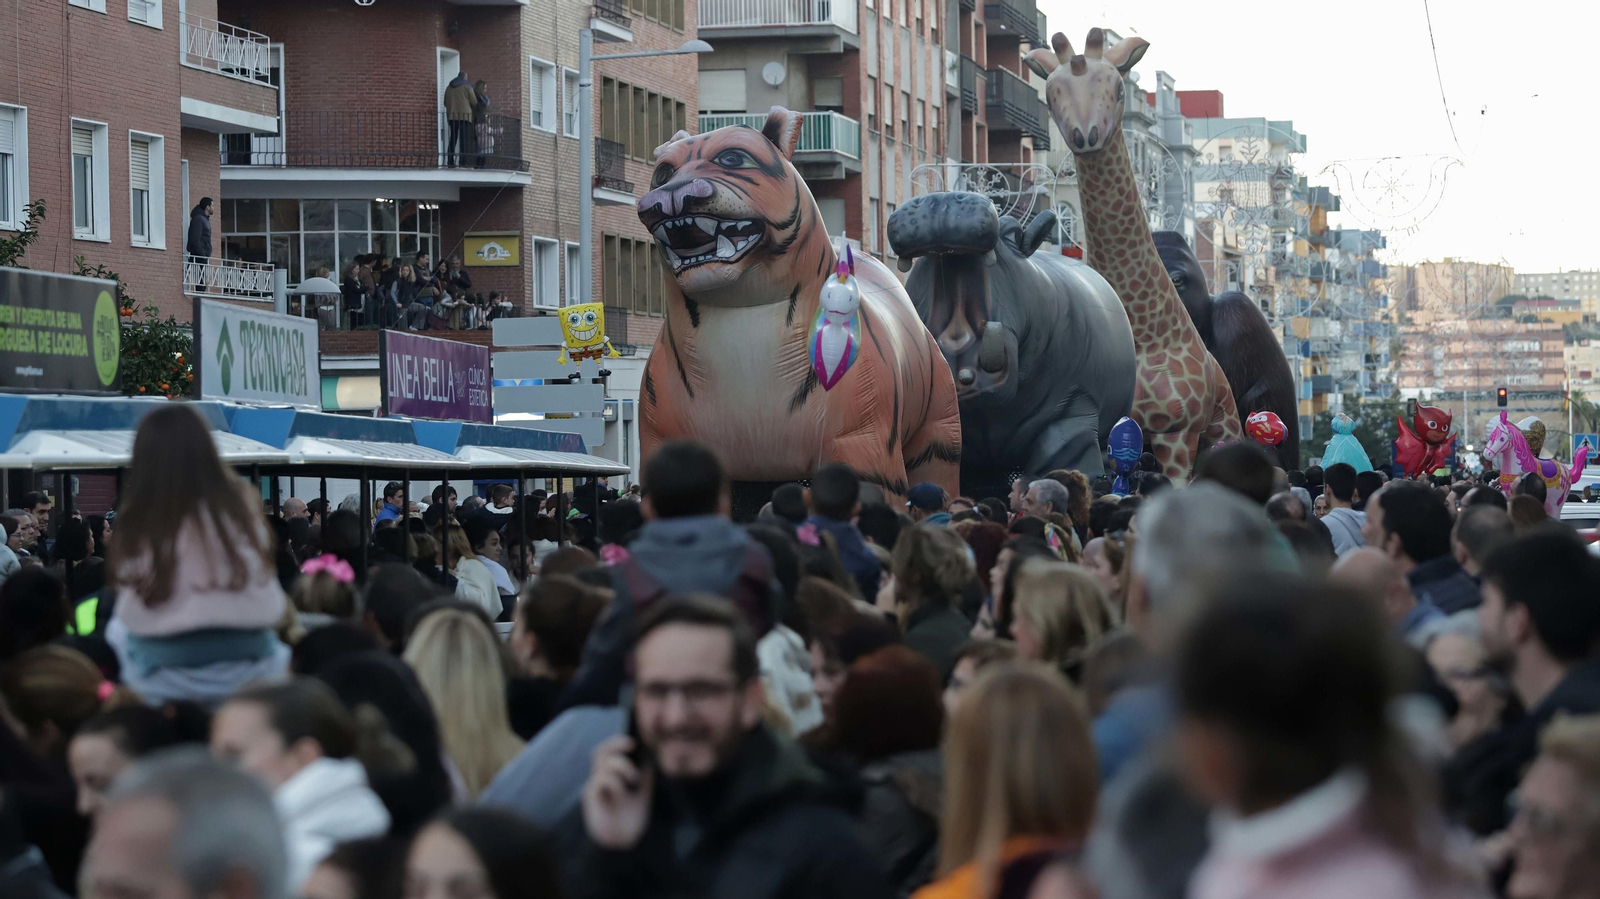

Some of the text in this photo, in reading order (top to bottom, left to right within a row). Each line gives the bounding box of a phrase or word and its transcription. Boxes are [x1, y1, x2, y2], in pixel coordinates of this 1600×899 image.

[16, 306, 22, 323] Y
[22, 308, 56, 326] DISFRUTA
[56, 311, 67, 327] DE
[67, 313, 82, 329] UNA
[39, 331, 51, 354] DE
[53, 333, 89, 356] LOCURA
[240, 320, 307, 396] TECNOCASA
[388, 352, 455, 403] LINEA BELLA
[469, 365, 485, 385] CLÍNICA
[469, 386, 489, 407] ESTÉTICA
